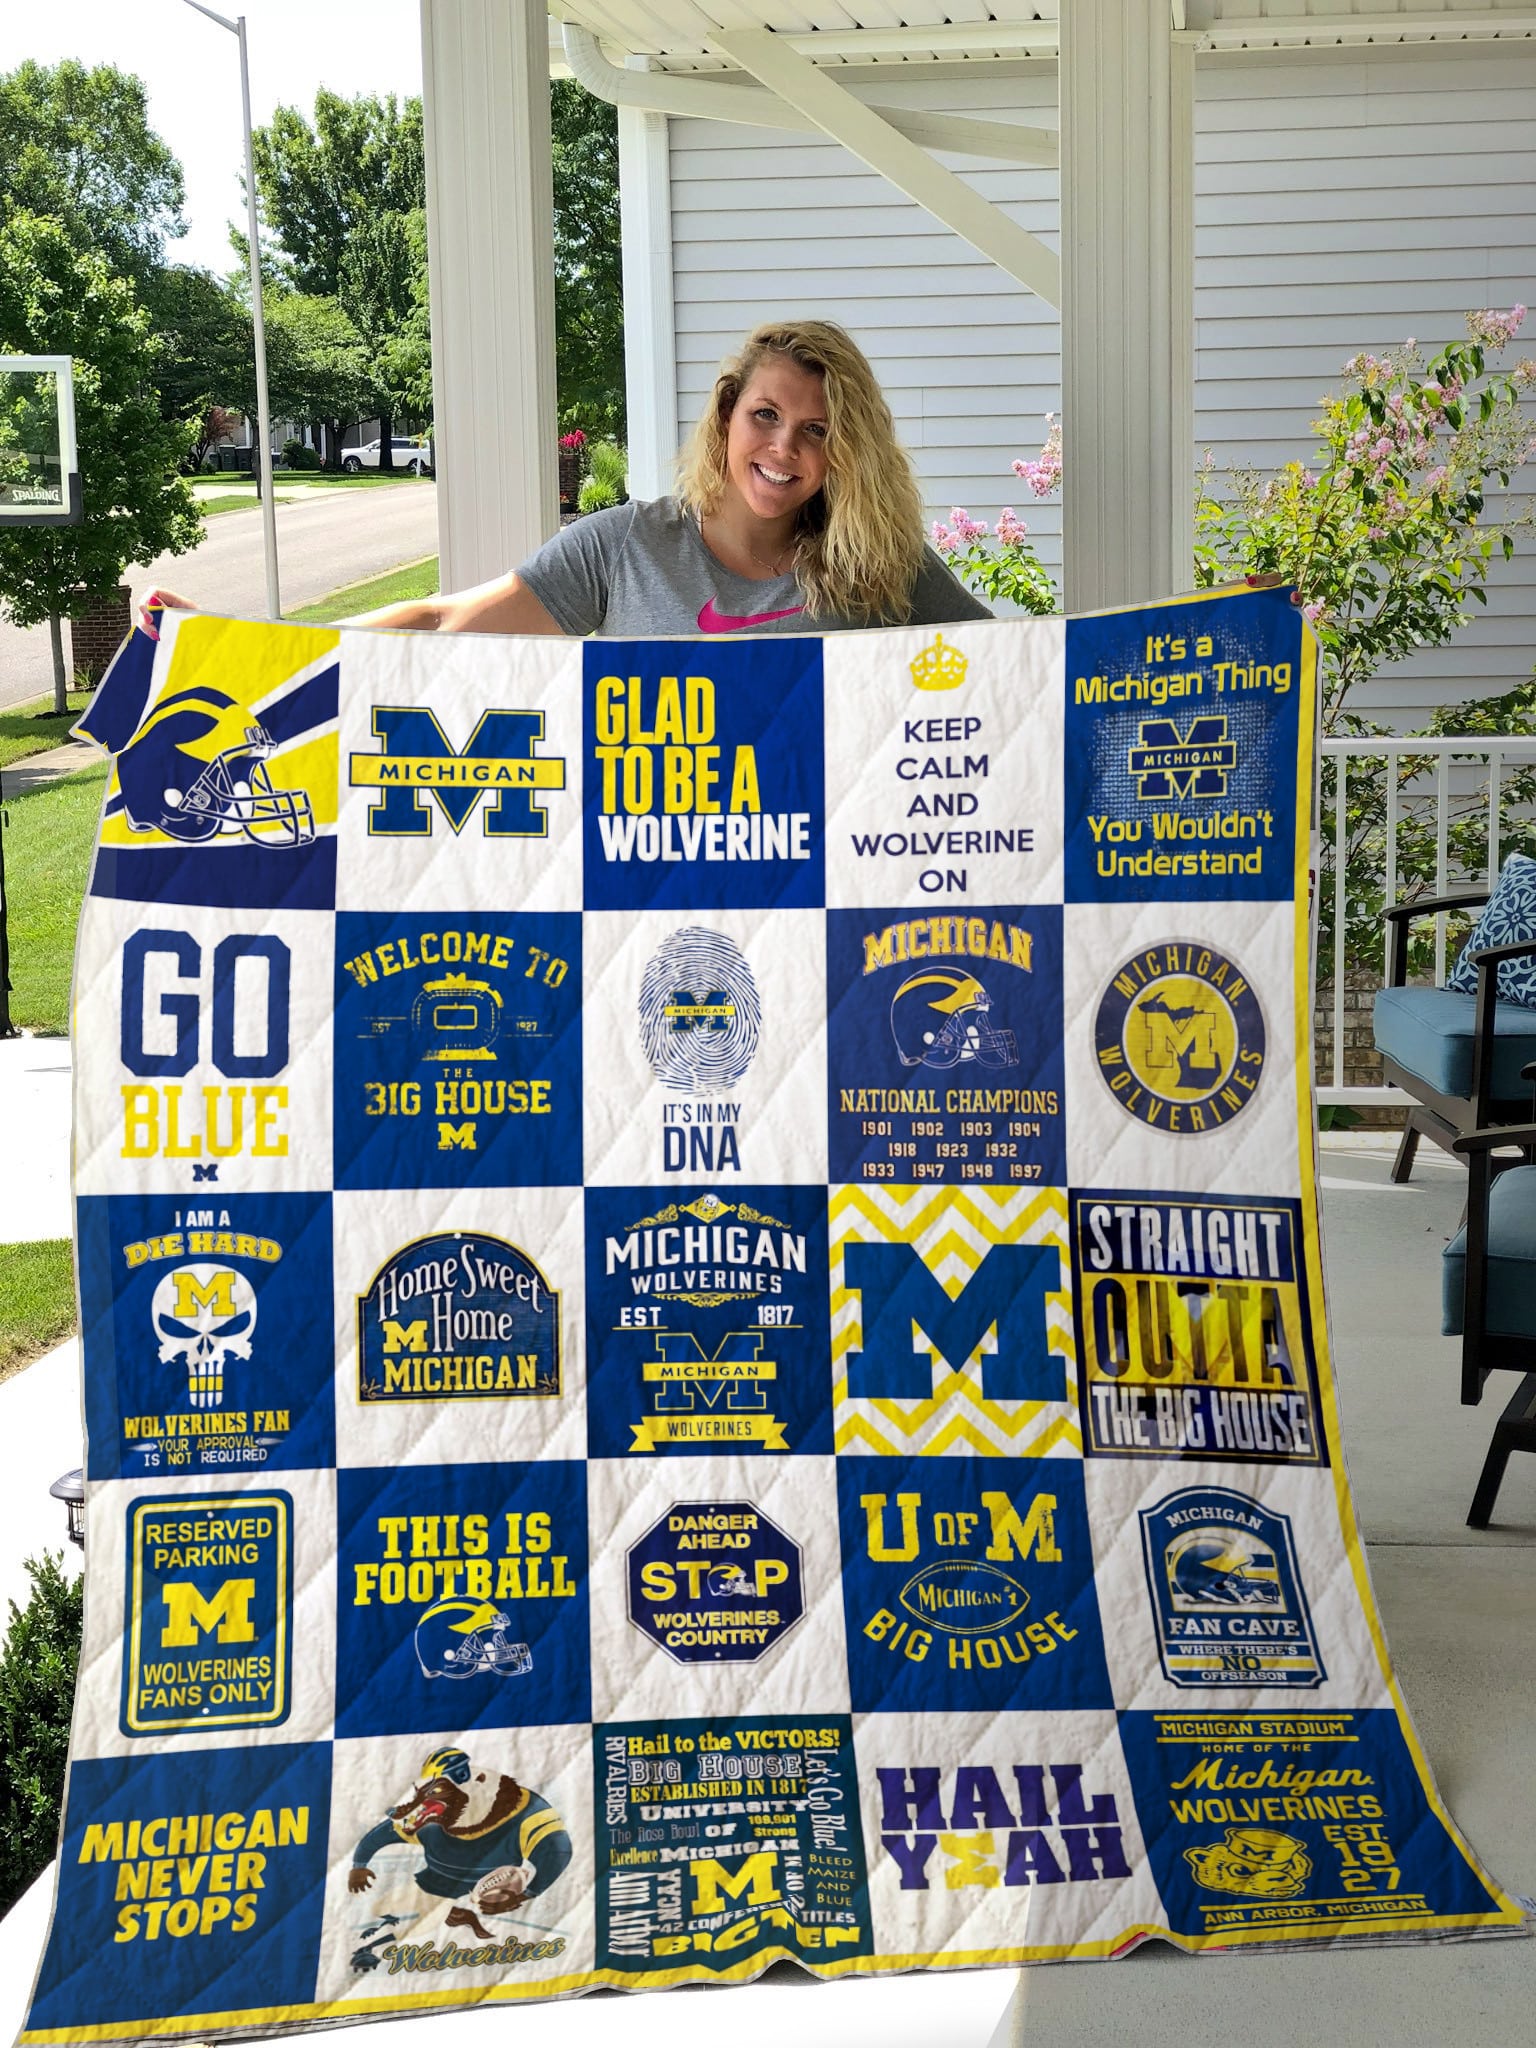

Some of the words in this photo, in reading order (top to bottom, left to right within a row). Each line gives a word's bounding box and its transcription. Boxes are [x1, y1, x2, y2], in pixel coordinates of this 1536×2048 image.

[12, 490, 61, 501] SPALDING
[1146, 634, 1186, 663] It's
[1196, 637, 1213, 657] a
[1075, 672, 1203, 705] Michigan
[1213, 660, 1291, 693] Thing
[596, 676, 715, 745] GLAD
[904, 717, 982, 743] KEEP
[896, 754, 988, 781] CALM
[1144, 751, 1223, 766] MICHIGAN
[379, 764, 535, 782] MICHIGAN
[595, 746, 653, 815] TO
[664, 746, 721, 814] BE
[730, 745, 761, 813] A
[907, 793, 978, 818] AND
[598, 813, 811, 862] WOLVERINE
[1088, 815, 1142, 842] You
[1152, 810, 1273, 840] Wouldn't
[851, 829, 1034, 856] WOLVERINE
[1098, 847, 1262, 876] Understand
[919, 870, 967, 893] ON
[343, 931, 514, 988] WELCOME
[525, 946, 568, 988] TO
[863, 916, 1033, 976] MICHIGAN
[1113, 945, 1248, 1002] MICHIGAN
[121, 928, 291, 1078] GO
[443, 1068, 473, 1078] THE
[435, 1080, 551, 1115] HOUSE
[840, 1089, 940, 1113] NATIONAL
[946, 1090, 1058, 1114] CHAMPIONS
[1098, 1045, 1263, 1131] WOLVERINES
[121, 1085, 289, 1158] BLUE
[664, 1104, 692, 1123] IT'S
[697, 1104, 712, 1122] IN
[718, 1104, 741, 1122] MY
[863, 1122, 892, 1135] 1901
[912, 1122, 944, 1136] 1902
[961, 1122, 992, 1136] 1903
[1009, 1122, 1041, 1137] 1904
[664, 1126, 741, 1172] DNA
[889, 1143, 917, 1157] 1918
[936, 1143, 968, 1157] 1923
[986, 1143, 1017, 1157] 1932
[863, 1163, 895, 1177] 1933
[912, 1164, 944, 1177] 1947
[961, 1164, 993, 1178] 1948
[1010, 1165, 1042, 1178] 1997
[175, 1211, 180, 1227] I
[186, 1210, 213, 1227] AM
[219, 1210, 230, 1226] A
[124, 1233, 184, 1268] DIE
[188, 1231, 283, 1262] HARD
[606, 1226, 807, 1275] MICHIGAN
[1089, 1205, 1281, 1277] STRAIGHT
[173, 1272, 236, 1317] M
[378, 1257, 458, 1322] Home
[460, 1244, 543, 1313] Sweet
[631, 1270, 782, 1295] WOLVERINES
[432, 1291, 513, 1352] Home
[620, 1306, 662, 1326] EST
[757, 1305, 794, 1325] 1817
[844, 1242, 1067, 1402] M
[383, 1321, 428, 1353] M
[1093, 1278, 1297, 1384] OUTTA
[383, 1355, 538, 1393] MICHIGAN
[661, 1366, 759, 1377] MICHIGAN
[124, 1411, 247, 1439] WOLVERINES
[253, 1410, 290, 1432] FAN
[667, 1422, 752, 1437] WOLVERINES
[1092, 1385, 1150, 1446] THE
[1155, 1387, 1206, 1447] BIG
[1210, 1390, 1311, 1453] HOUSE
[144, 1454, 160, 1466] IS
[167, 1452, 192, 1465] NOT
[201, 1449, 267, 1463] REQUIRED
[157, 1439, 188, 1452] YOUR
[196, 1436, 257, 1451] APPROVAL
[146, 1518, 273, 1545] RESERVED
[669, 1514, 758, 1532] DANGER
[860, 1493, 921, 1562] U
[933, 1512, 979, 1546] OF
[981, 1491, 1063, 1562] M
[1165, 1506, 1263, 1530] MICHIGAN
[378, 1515, 489, 1558] THIS
[505, 1512, 551, 1554] IS
[677, 1534, 751, 1549] AHEAD
[154, 1543, 259, 1569] PARKING
[354, 1556, 576, 1606] FOOTBALL
[161, 1578, 256, 1647] M
[653, 1610, 781, 1629] WOLVERINES
[666, 1629, 768, 1647] COUNTRY
[863, 1608, 933, 1662] BIG
[949, 1611, 1078, 1669] HOUSE
[1168, 1618, 1221, 1635] FAN
[1228, 1618, 1300, 1636] CAVE
[1179, 1645, 1233, 1655] WHERE
[1235, 1646, 1298, 1655] THERE'S
[1219, 1656, 1262, 1671] NO
[143, 1656, 271, 1686] WOLVERINES
[1201, 1671, 1287, 1681] OFFSEASON
[139, 1685, 202, 1710] FANS
[209, 1681, 272, 1704] ONLY
[628, 1734, 671, 1756] Hail
[674, 1736, 694, 1753] to
[699, 1731, 732, 1752] the
[735, 1729, 841, 1750] VICTORS!
[1161, 1723, 1253, 1736] MICHIGAN
[1260, 1722, 1345, 1734] STADIUM
[1202, 1745, 1244, 1753] HOME
[1281, 1744, 1312, 1752] THE
[606, 1736, 628, 1825] RIVALRIES
[631, 1781, 742, 1803] ESTABLISHED
[746, 1781, 765, 1795] IN
[771, 1778, 808, 1795] 1817
[876, 1764, 1119, 1831] HAIL
[1169, 1795, 1384, 1823] WOLVERINES
[78, 1806, 309, 1864] MICHIGAN
[705, 1823, 737, 1838] OF
[1323, 1824, 1388, 1842] EST.
[809, 1853, 853, 1866] BLEED
[1334, 1842, 1396, 1867] 19
[114, 1852, 267, 1901] NEVER
[690, 1852, 783, 1915] M
[807, 1867, 856, 1880] MAIZE
[817, 1881, 850, 1892] AND
[1340, 1867, 1401, 1892] 27
[657, 1868, 681, 1922] NCAA
[817, 1893, 852, 1907] BLUE
[114, 1893, 258, 1943] STOPS
[1204, 1912, 1245, 1925] ANN
[1327, 1900, 1427, 1915] MICHIGAN
[382, 1935, 566, 1975] Wolverines
